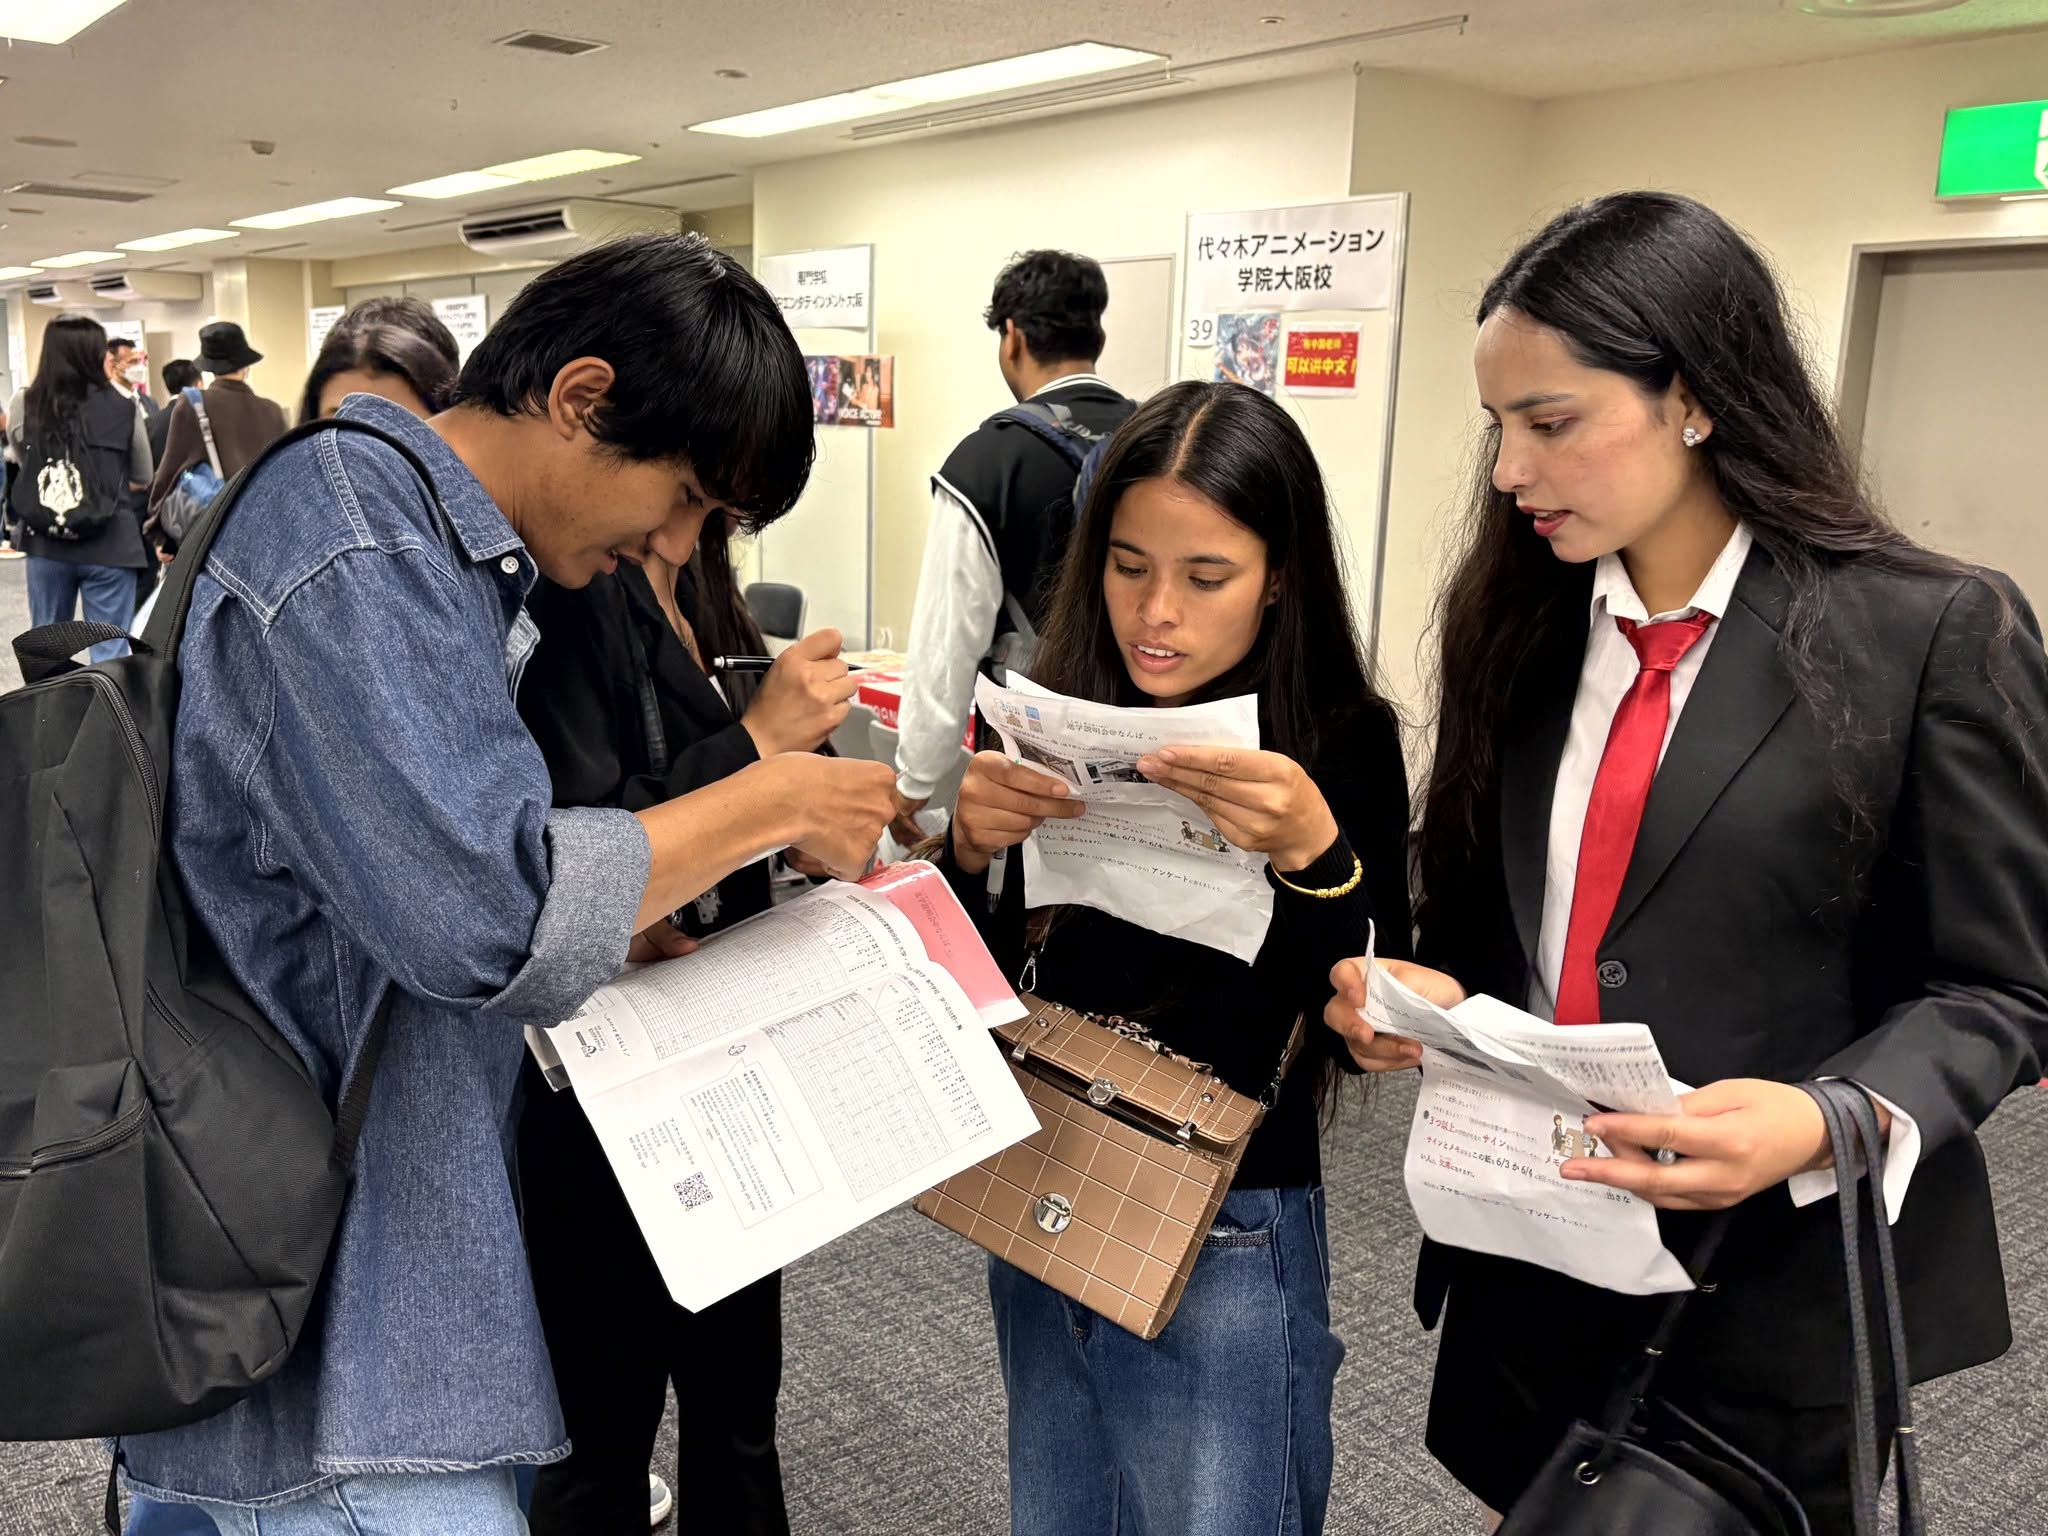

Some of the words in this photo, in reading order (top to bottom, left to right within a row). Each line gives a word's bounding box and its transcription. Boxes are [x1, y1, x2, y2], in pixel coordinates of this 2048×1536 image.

[1198, 229, 1385, 261] 代々木アニメーション
[1238, 264, 1333, 292] 学院大阪校
[1189, 319, 1213, 341] 39
[1496, 1158, 1510, 1169] 6/3
